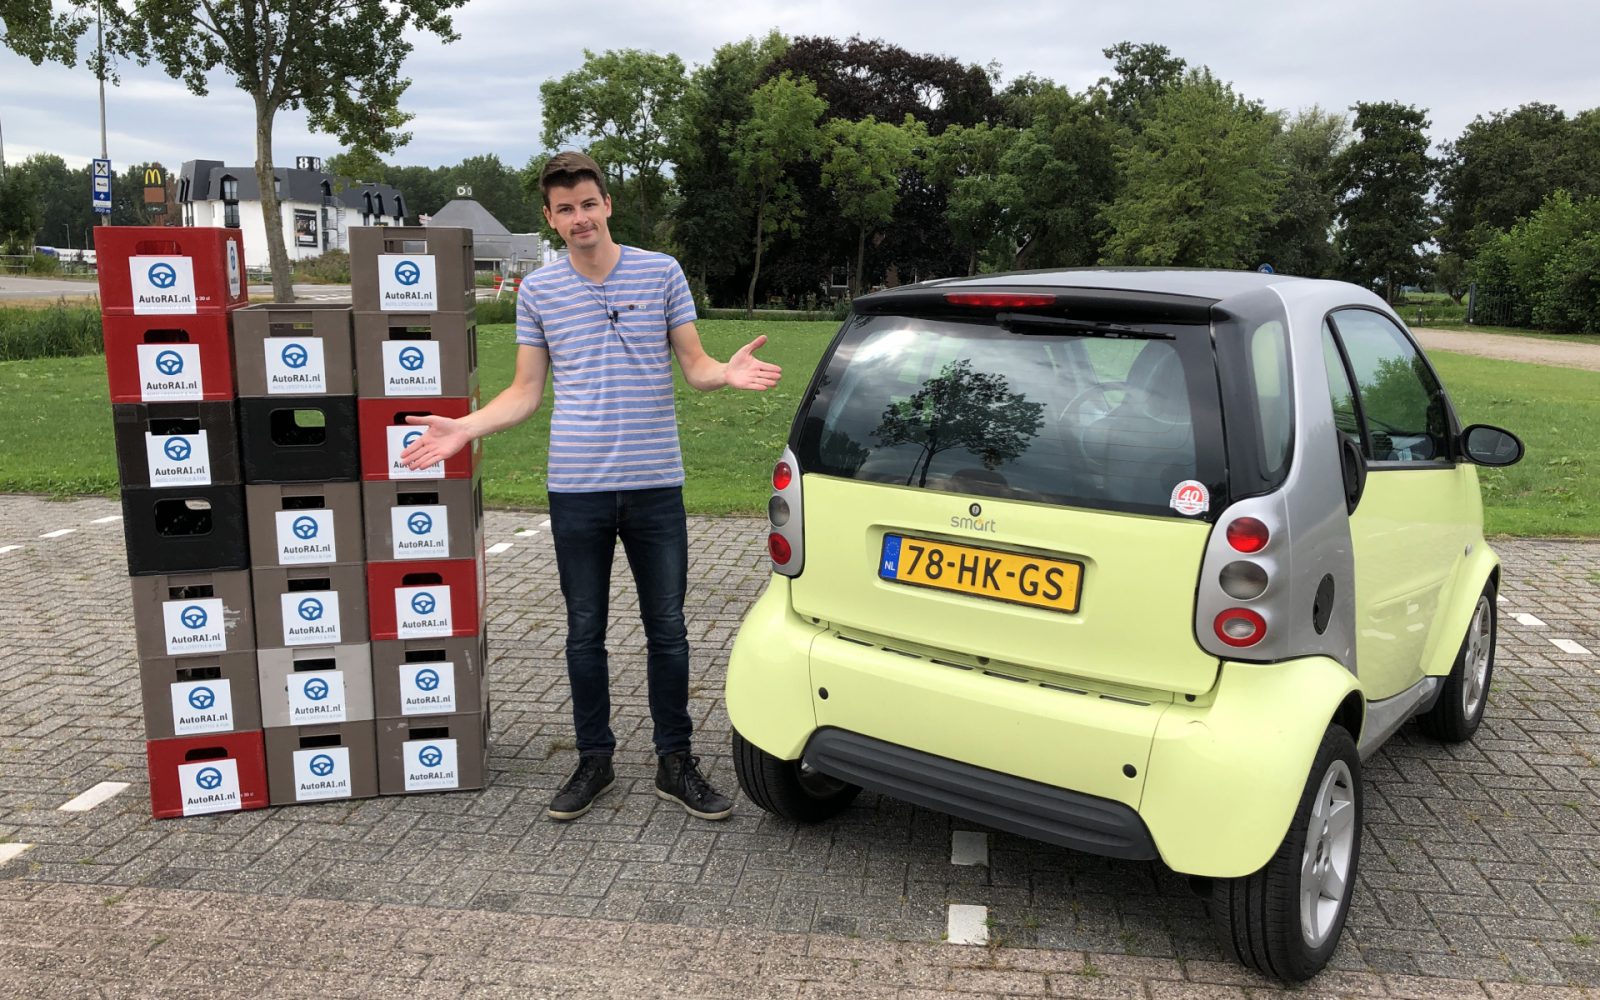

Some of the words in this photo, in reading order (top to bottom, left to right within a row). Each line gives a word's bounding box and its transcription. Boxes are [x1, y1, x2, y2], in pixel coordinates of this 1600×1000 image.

[139, 295, 191, 303] AutoRAI.nl
[385, 291, 432, 300] AutoRAI.nl
[272, 373, 321, 382] AutoRAI.nl
[390, 376, 436, 385] AutoRAI.nl
[146, 381, 197, 390] AutoRAI.nl
[155, 466, 205, 476] AutoRAI.nl
[1180, 489, 1200, 503] 40
[950, 515, 996, 533] smart
[283, 544, 331, 554] AutoRAI.nl
[398, 539, 444, 549] AutoRAI.nl
[884, 560, 896, 571] NL
[906, 544, 1065, 601] 78-HK-GS
[402, 619, 448, 628] AutoRAI.nl
[288, 625, 336, 635] AutoRAI.nl
[171, 633, 221, 643] AutoRAI.nl
[406, 696, 451, 705] AutoRAI.nl
[294, 705, 341, 716] AutoRAI.nl
[179, 713, 228, 724] AutoRAI.nl
[409, 771, 454, 781] AutoRAI.nl
[300, 780, 346, 791] AutoRAI.nl
[187, 792, 236, 805] AutoRAI.nl
